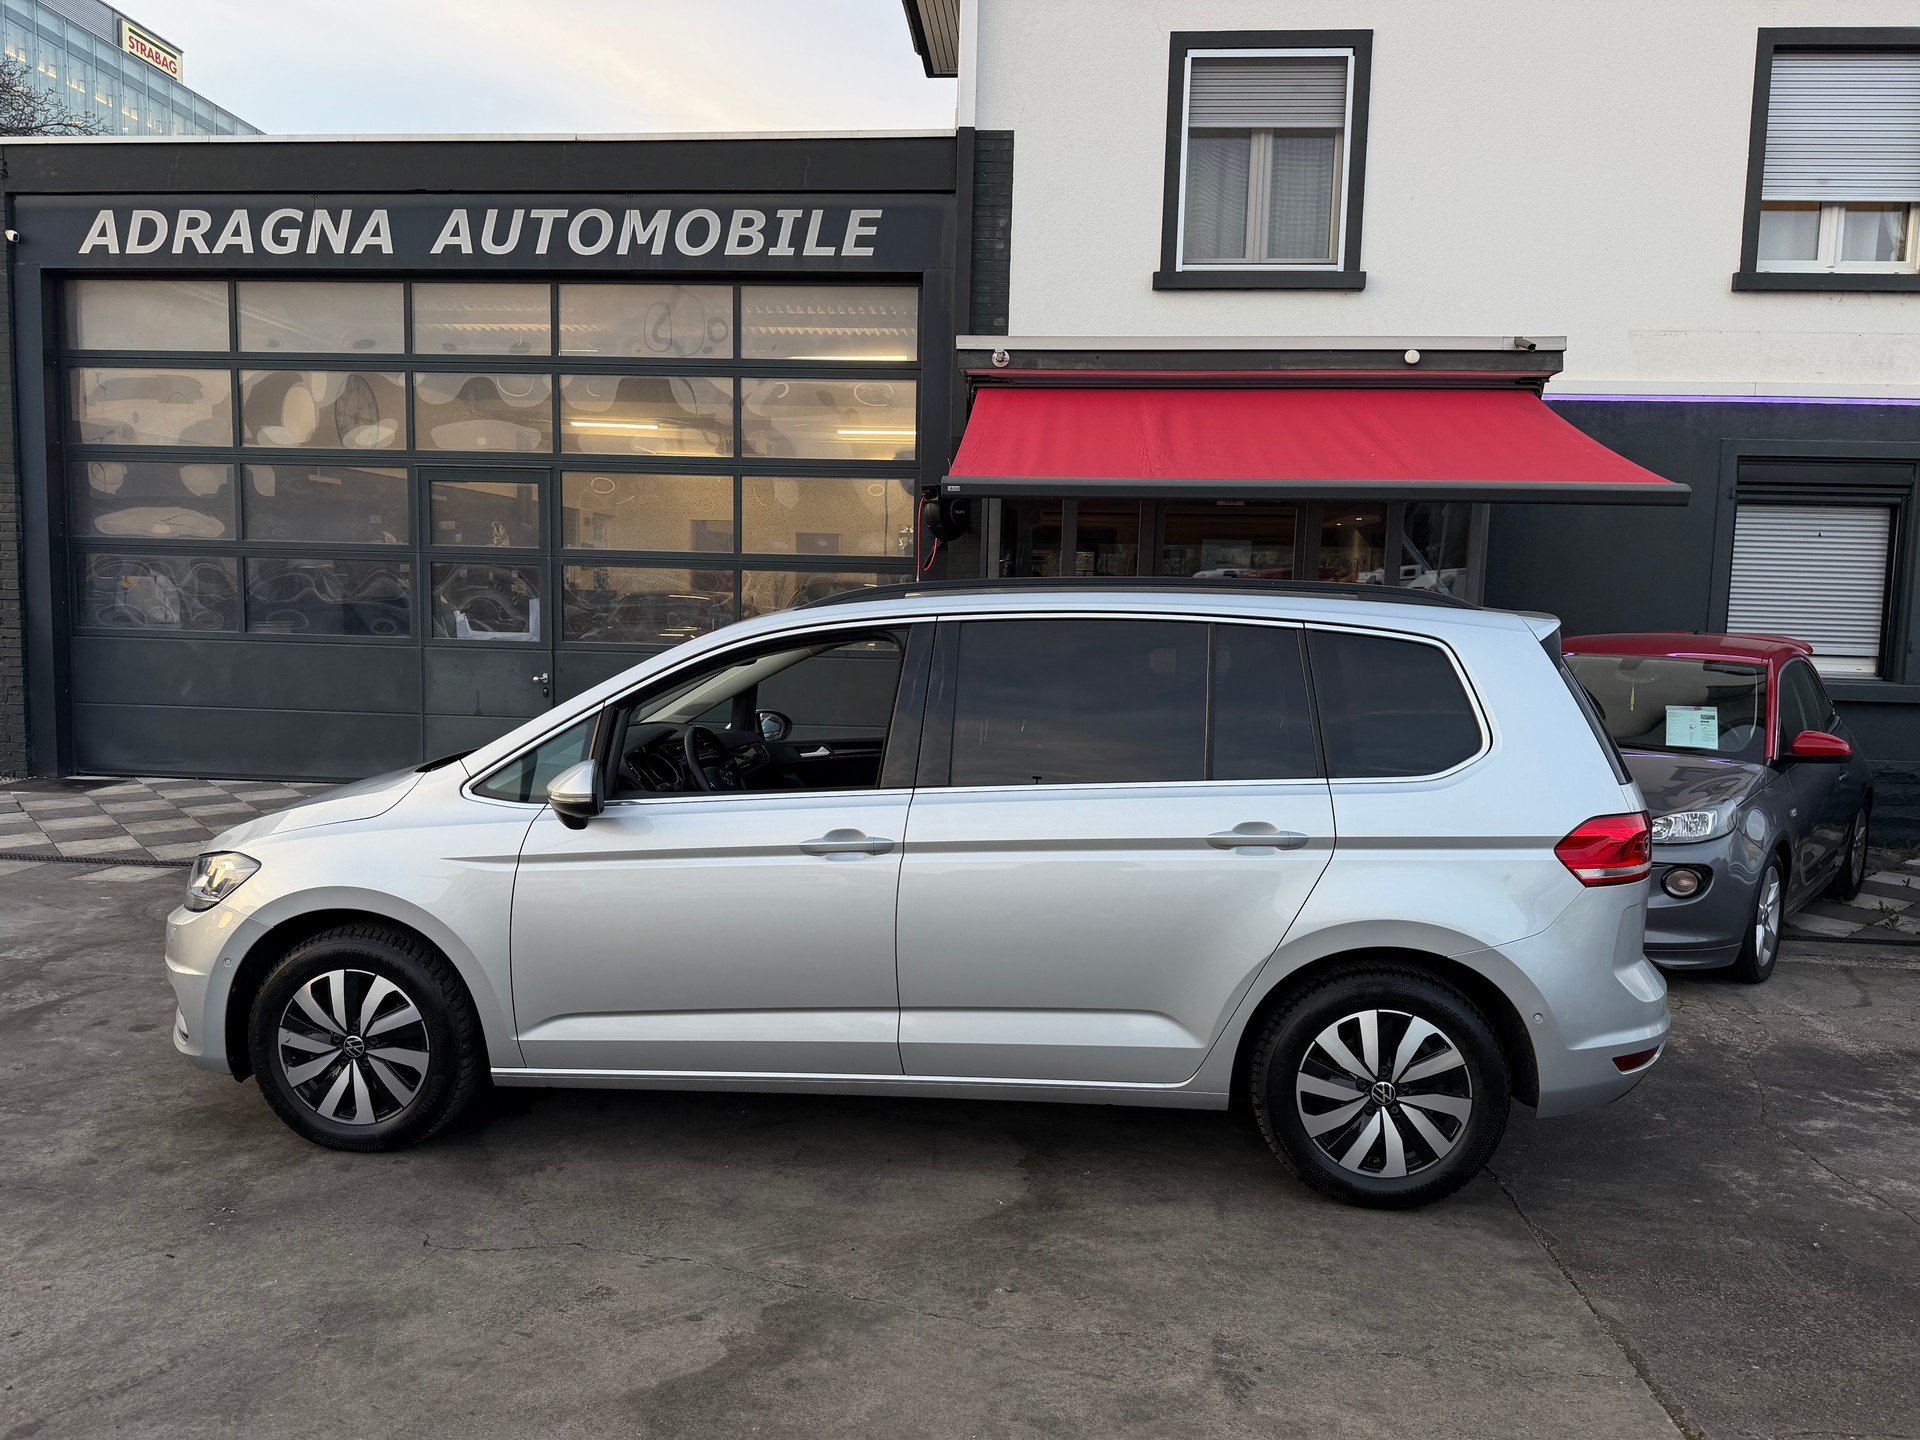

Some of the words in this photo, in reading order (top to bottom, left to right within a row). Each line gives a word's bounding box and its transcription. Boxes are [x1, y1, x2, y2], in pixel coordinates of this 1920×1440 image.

[128, 35, 178, 75] STRABAG
[78, 208, 394, 255] ADRAGNA
[430, 207, 883, 258] AUTOMOBILE
